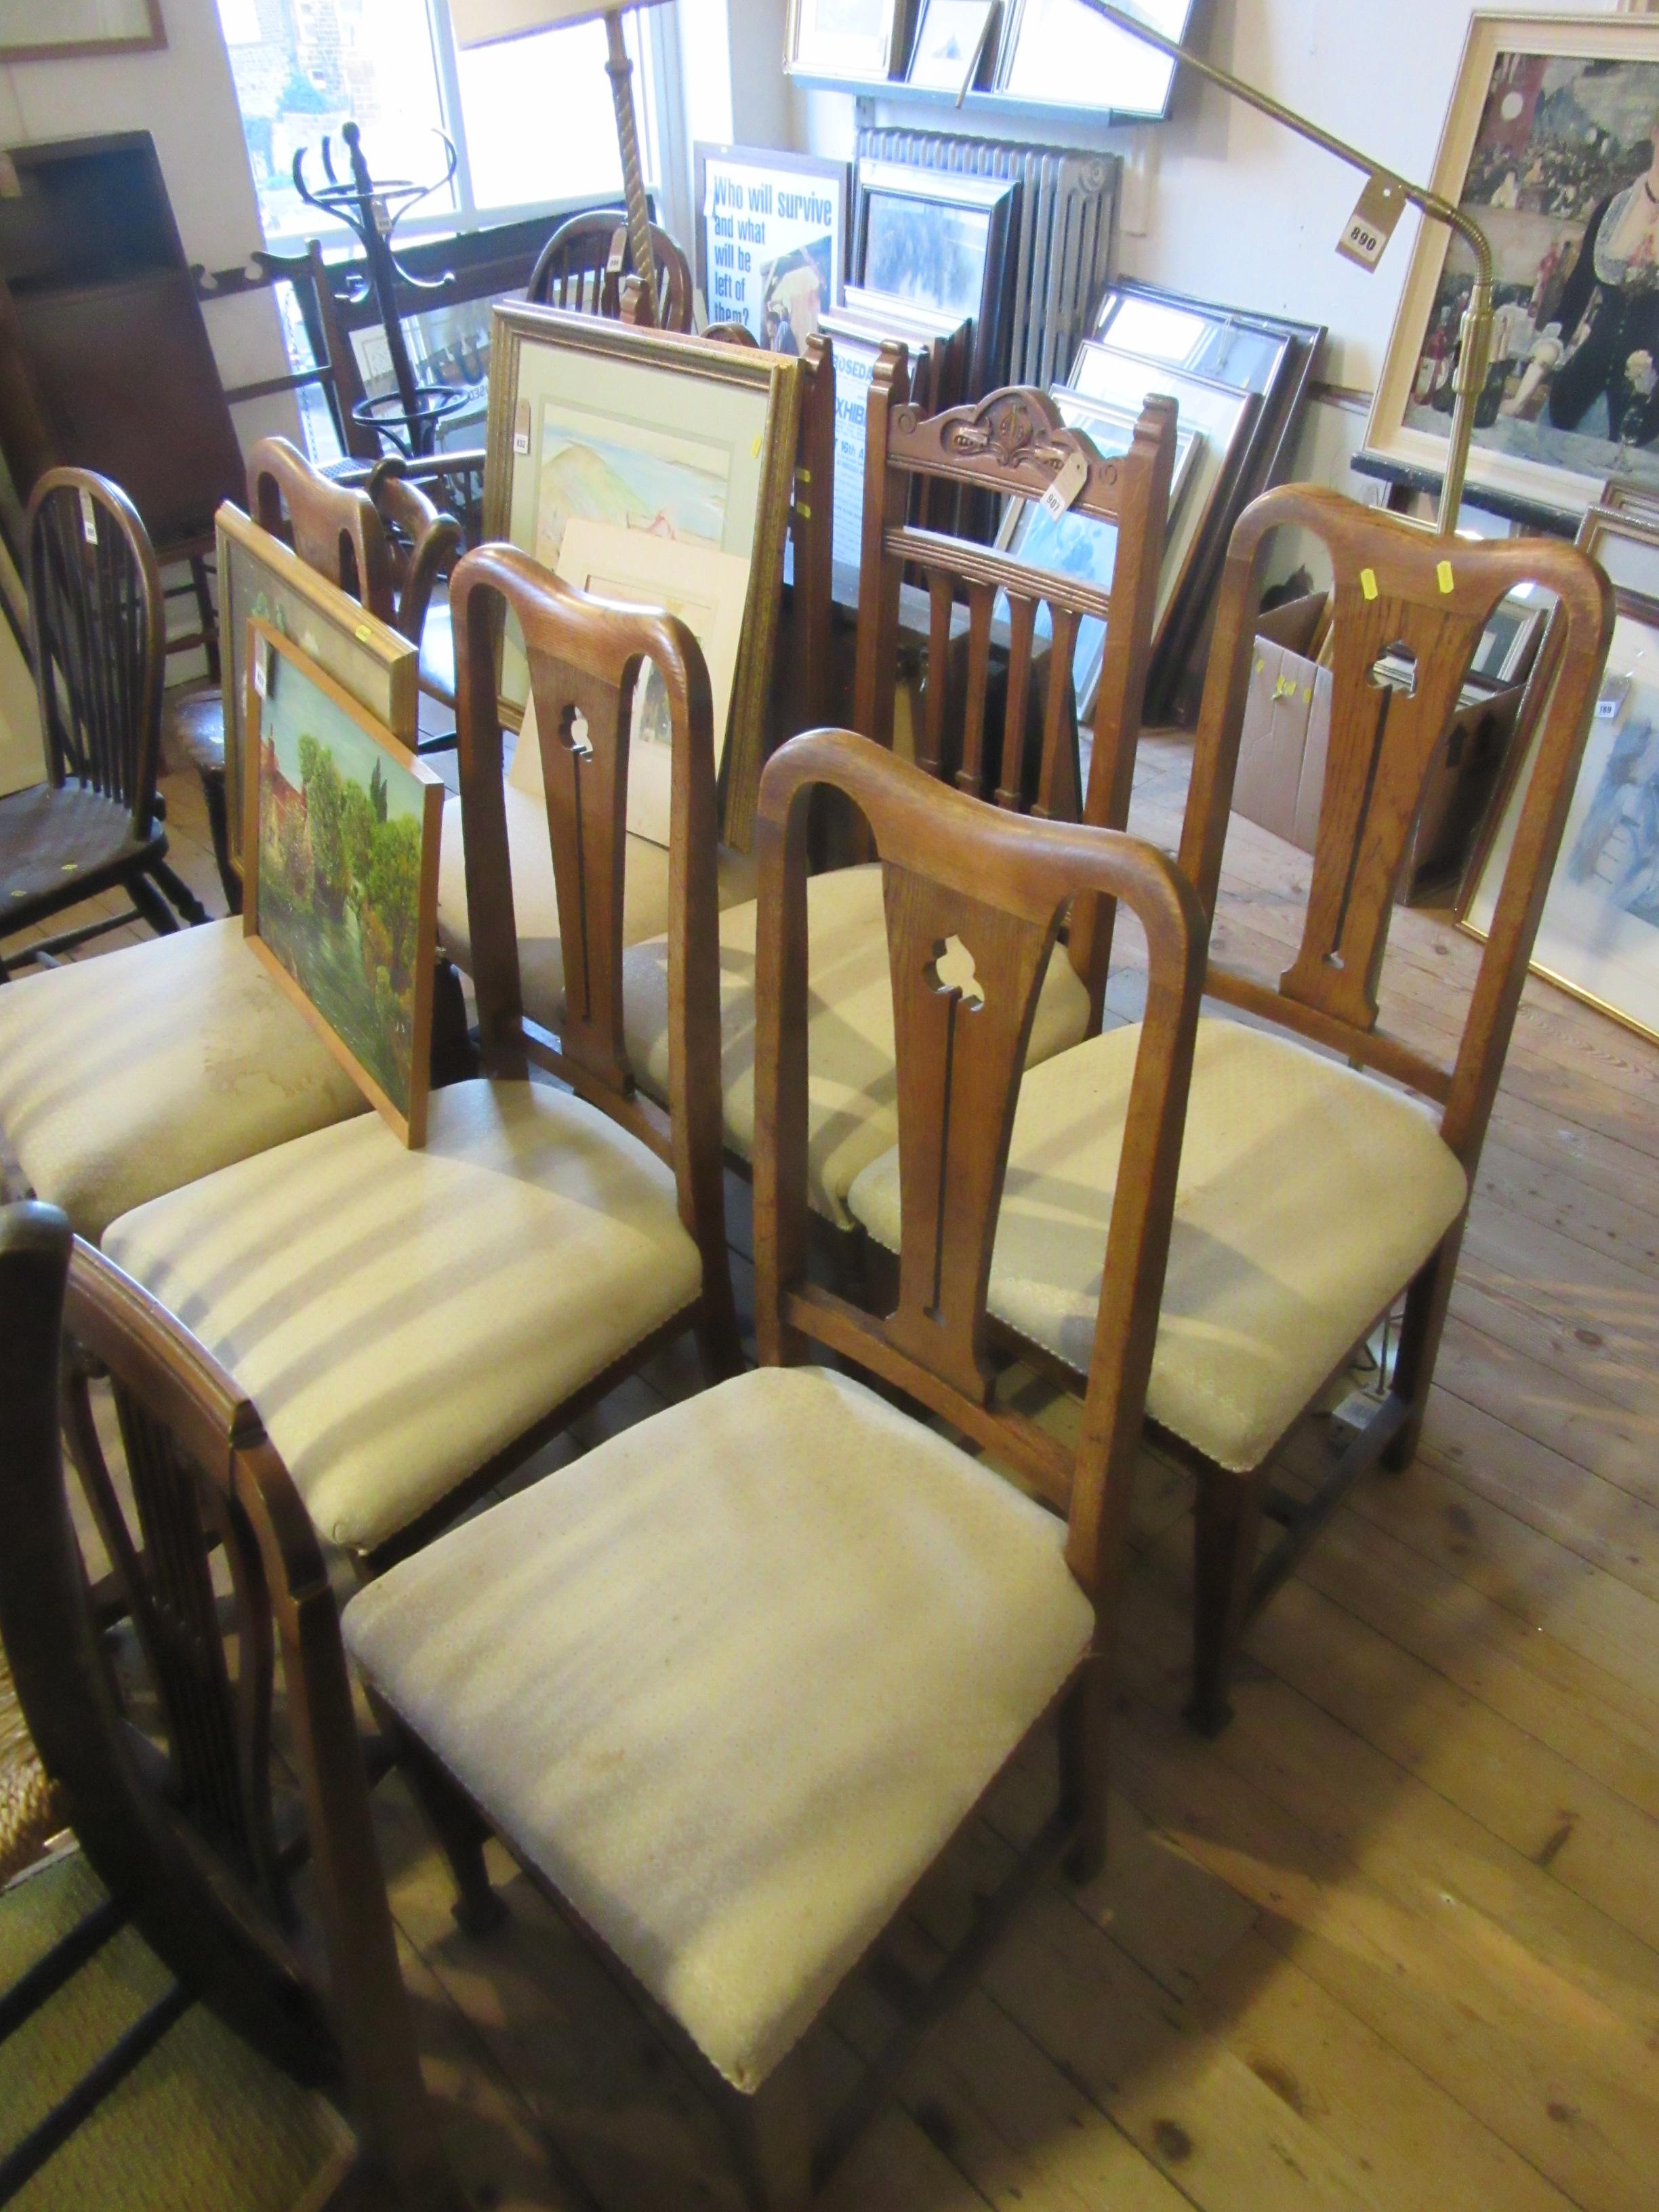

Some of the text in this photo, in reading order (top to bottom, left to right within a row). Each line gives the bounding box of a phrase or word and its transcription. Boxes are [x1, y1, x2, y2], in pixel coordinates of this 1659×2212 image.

[714, 176, 832, 227] Who will survive
[714, 214, 765, 244] and what
[1351, 227, 1376, 251] 890
[714, 243, 752, 272] will be
[714, 271, 745, 302] left of
[714, 301, 749, 326] them?
